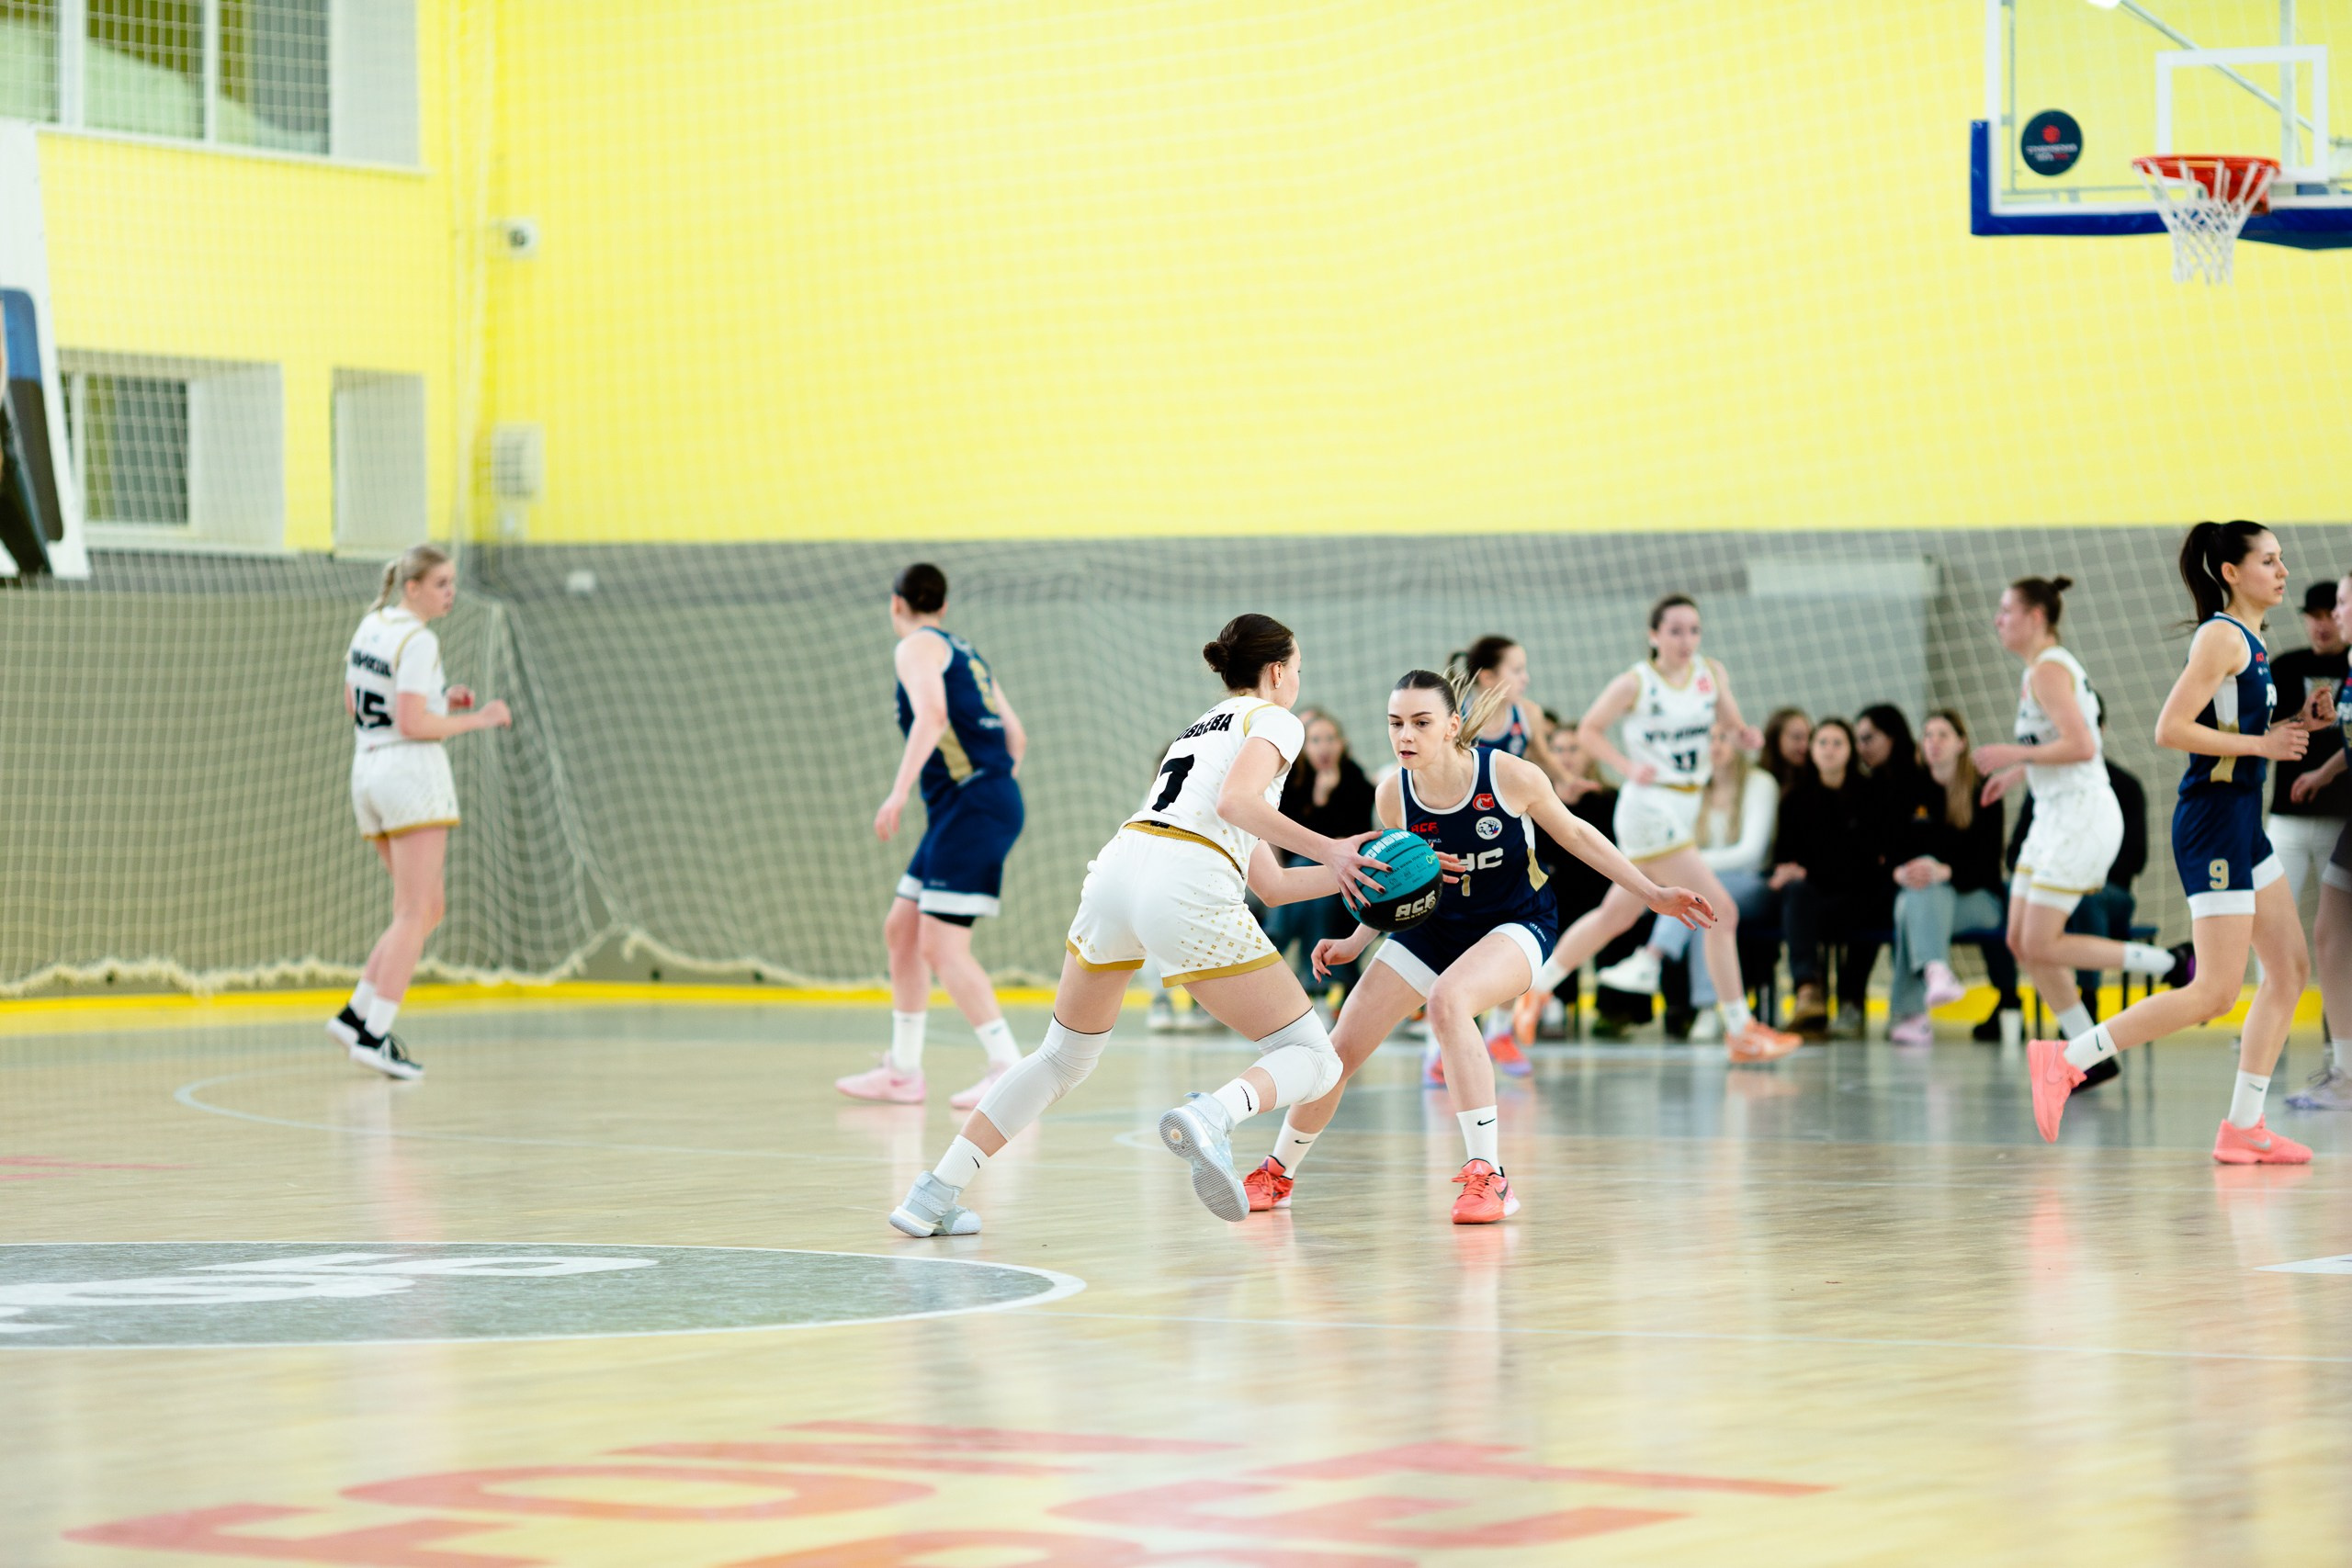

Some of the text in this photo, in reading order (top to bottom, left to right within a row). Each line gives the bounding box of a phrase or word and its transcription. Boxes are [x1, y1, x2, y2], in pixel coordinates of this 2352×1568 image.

[355, 685, 393, 729] 15
[1175, 713, 1235, 742] ОВЬЕВА
[1152, 754, 1194, 813] 7
[1449, 847, 1504, 872] УС
[2209, 858, 2230, 891] 9
[1461, 874, 1471, 897] 1
